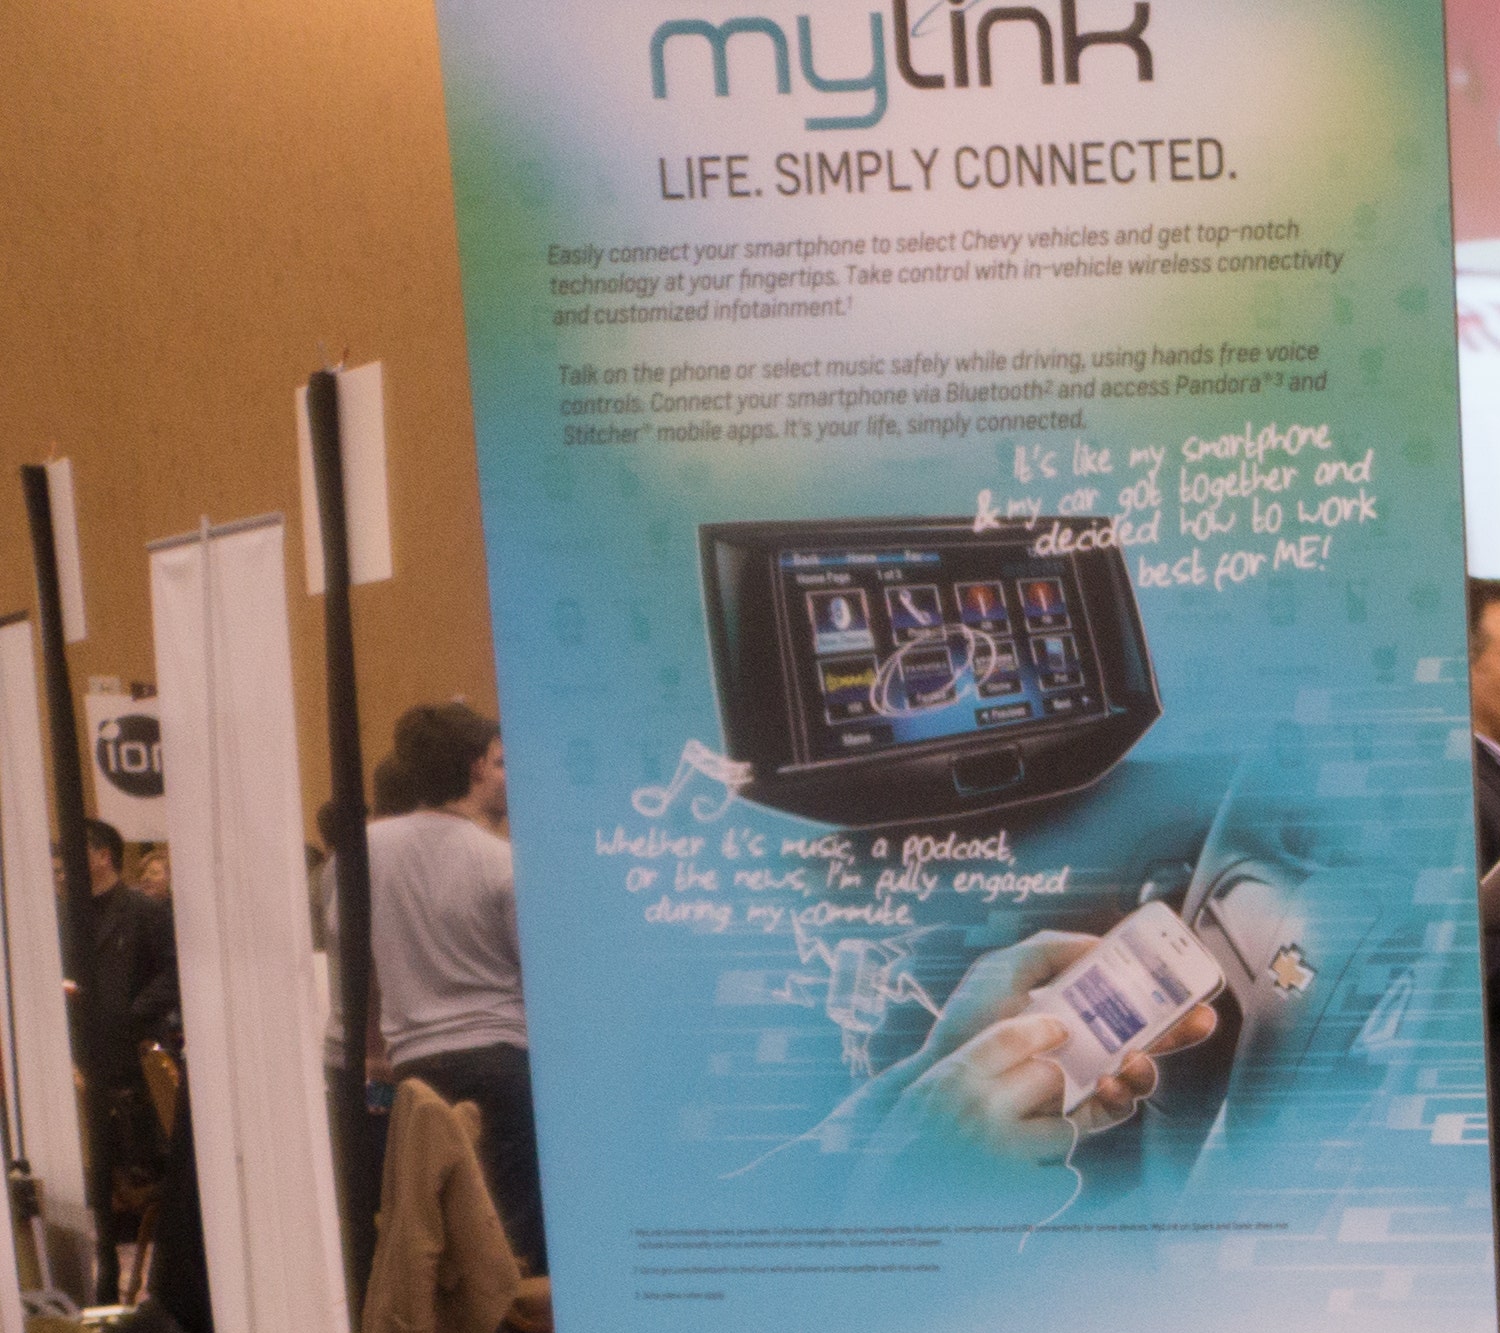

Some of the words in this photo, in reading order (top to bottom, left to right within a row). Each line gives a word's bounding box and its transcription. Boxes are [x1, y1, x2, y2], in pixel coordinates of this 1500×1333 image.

[649, 0, 1155, 131] mylink
[659, 154, 763, 201] LIFE.
[775, 146, 940, 195] SIMPLY
[953, 138, 1237, 188] CONNECTED.
[547, 243, 604, 268] Easily
[609, 243, 689, 264] connect
[694, 244, 738, 265] your
[744, 234, 865, 260] smartphone
[872, 235, 891, 254] to
[896, 231, 956, 254] select
[961, 228, 1022, 254] Chevy
[1027, 225, 1109, 248] vehicles
[1115, 222, 1153, 246] and
[1158, 223, 1190, 250] get
[1197, 218, 1300, 249] top-notch
[550, 271, 659, 298] technology
[664, 273, 684, 293] at
[689, 273, 732, 297] your
[739, 265, 840, 293] fingertips.
[846, 264, 893, 285] Take
[899, 259, 969, 284] control
[975, 259, 1018, 280] with
[1024, 253, 1122, 278] in-vehicle
[1128, 251, 1212, 276] wireless
[1217, 248, 1344, 275] connectivity
[552, 304, 590, 326] and
[594, 300, 708, 325] customized
[559, 363, 600, 386] Talk
[604, 366, 628, 384] on
[633, 362, 664, 383] the
[669, 360, 730, 387] phone
[735, 361, 758, 380] or
[762, 355, 821, 379] select
[826, 354, 885, 376] music
[890, 351, 949, 378] safely
[956, 348, 1007, 372] while
[1012, 347, 1086, 375] driving,
[1092, 344, 1146, 372] using
[1151, 341, 1214, 366] hands
[1219, 341, 1260, 368] free
[1265, 340, 1320, 362] voice
[559, 394, 642, 417] controls.
[650, 390, 732, 413] Connect
[737, 393, 780, 420] your
[786, 385, 907, 412] smartphone
[913, 382, 940, 402] via
[1058, 376, 1095, 399] and
[1101, 377, 1169, 399] access
[1289, 369, 1327, 392] and
[657, 419, 721, 443] mobile
[726, 421, 778, 447] apps.
[784, 417, 812, 438] It's
[815, 419, 859, 443] your
[866, 414, 898, 440] life,
[907, 411, 970, 437] simply
[975, 409, 1088, 432] connected.
[1014, 444, 1058, 484] It's
[1073, 438, 1113, 477] like
[1130, 445, 1165, 475] my
[1182, 421, 1332, 466] smartphone
[1007, 497, 1042, 531] my
[1059, 487, 1099, 516] car
[1120, 470, 1162, 517] got
[1179, 464, 1296, 510] together
[1315, 448, 1373, 487] and
[1034, 510, 1161, 557] decided
[1179, 506, 1237, 541] how
[1252, 497, 1283, 534] to
[1298, 489, 1378, 528] work
[1138, 549, 1208, 588] best
[1214, 550, 1268, 593] for
[1274, 535, 1333, 572] ME!
[596, 827, 706, 858] Whether
[781, 834, 856, 865] music,
[871, 838, 888, 859] a
[902, 830, 1017, 865] podcast,
[625, 866, 658, 893] or
[674, 860, 719, 892] the
[733, 866, 810, 896] news,
[826, 861, 862, 890] I'm
[875, 863, 937, 900] fully
[953, 865, 1071, 904] engaged
[644, 896, 733, 933] during
[746, 905, 786, 933] my
